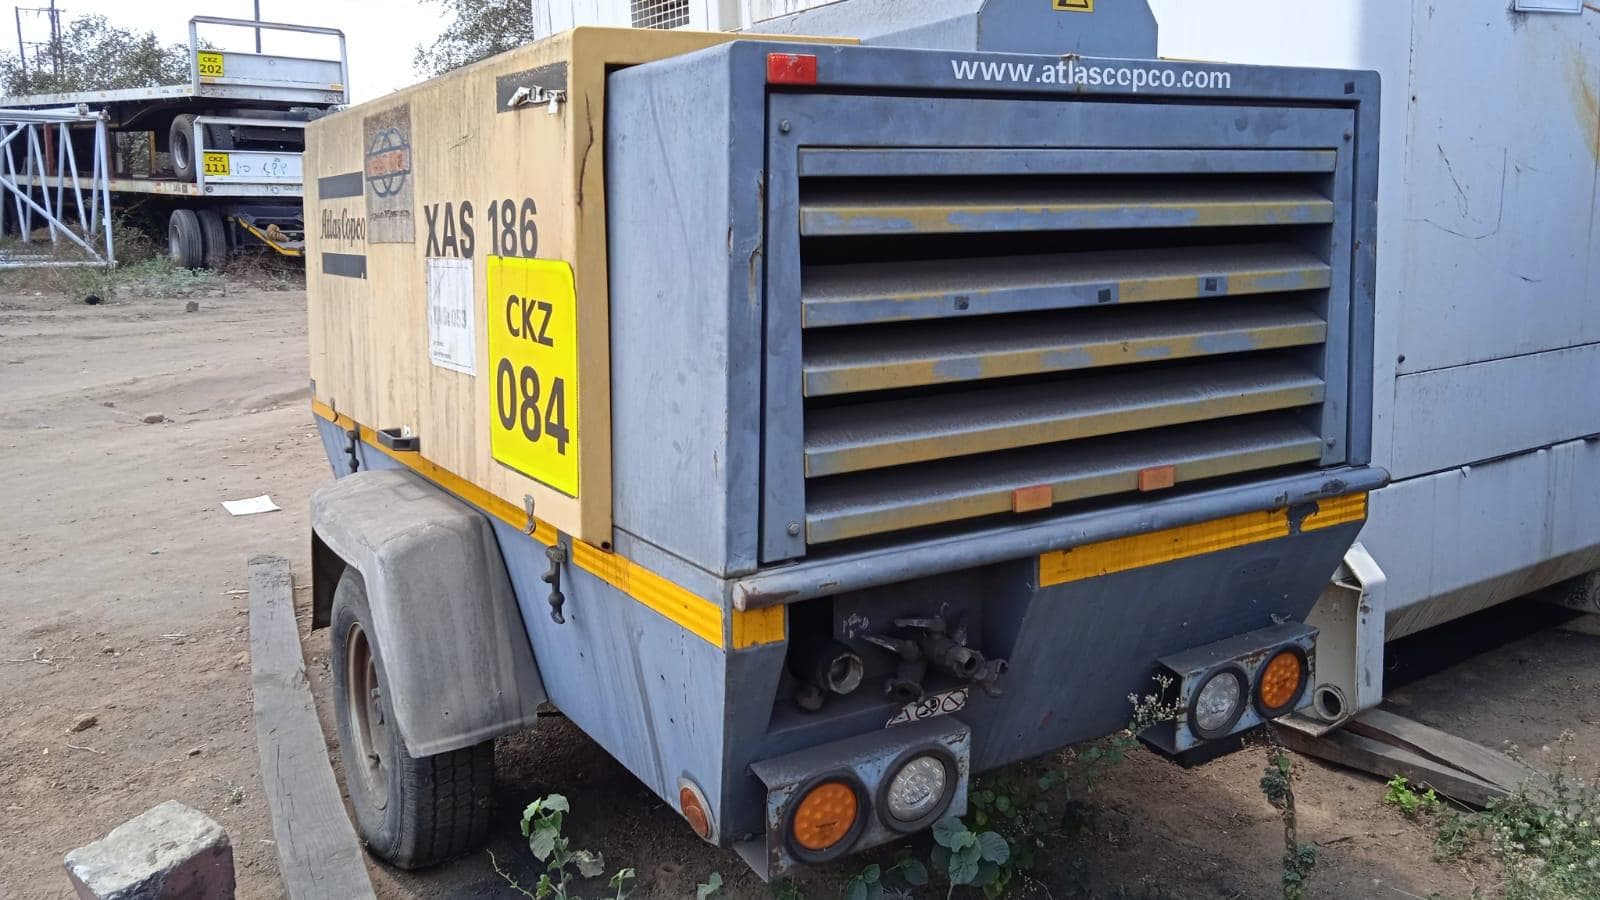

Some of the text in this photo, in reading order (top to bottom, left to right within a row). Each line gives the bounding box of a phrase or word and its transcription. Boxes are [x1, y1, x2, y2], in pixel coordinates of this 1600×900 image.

[199, 64, 222, 74] 202
[951, 60, 1232, 92] www.atlascopco.com
[205, 163, 228, 173] 111
[320, 207, 366, 248] Atlas Copco
[424, 198, 538, 258] XAS 186
[506, 294, 554, 347] CKZ
[496, 357, 570, 456] 084
